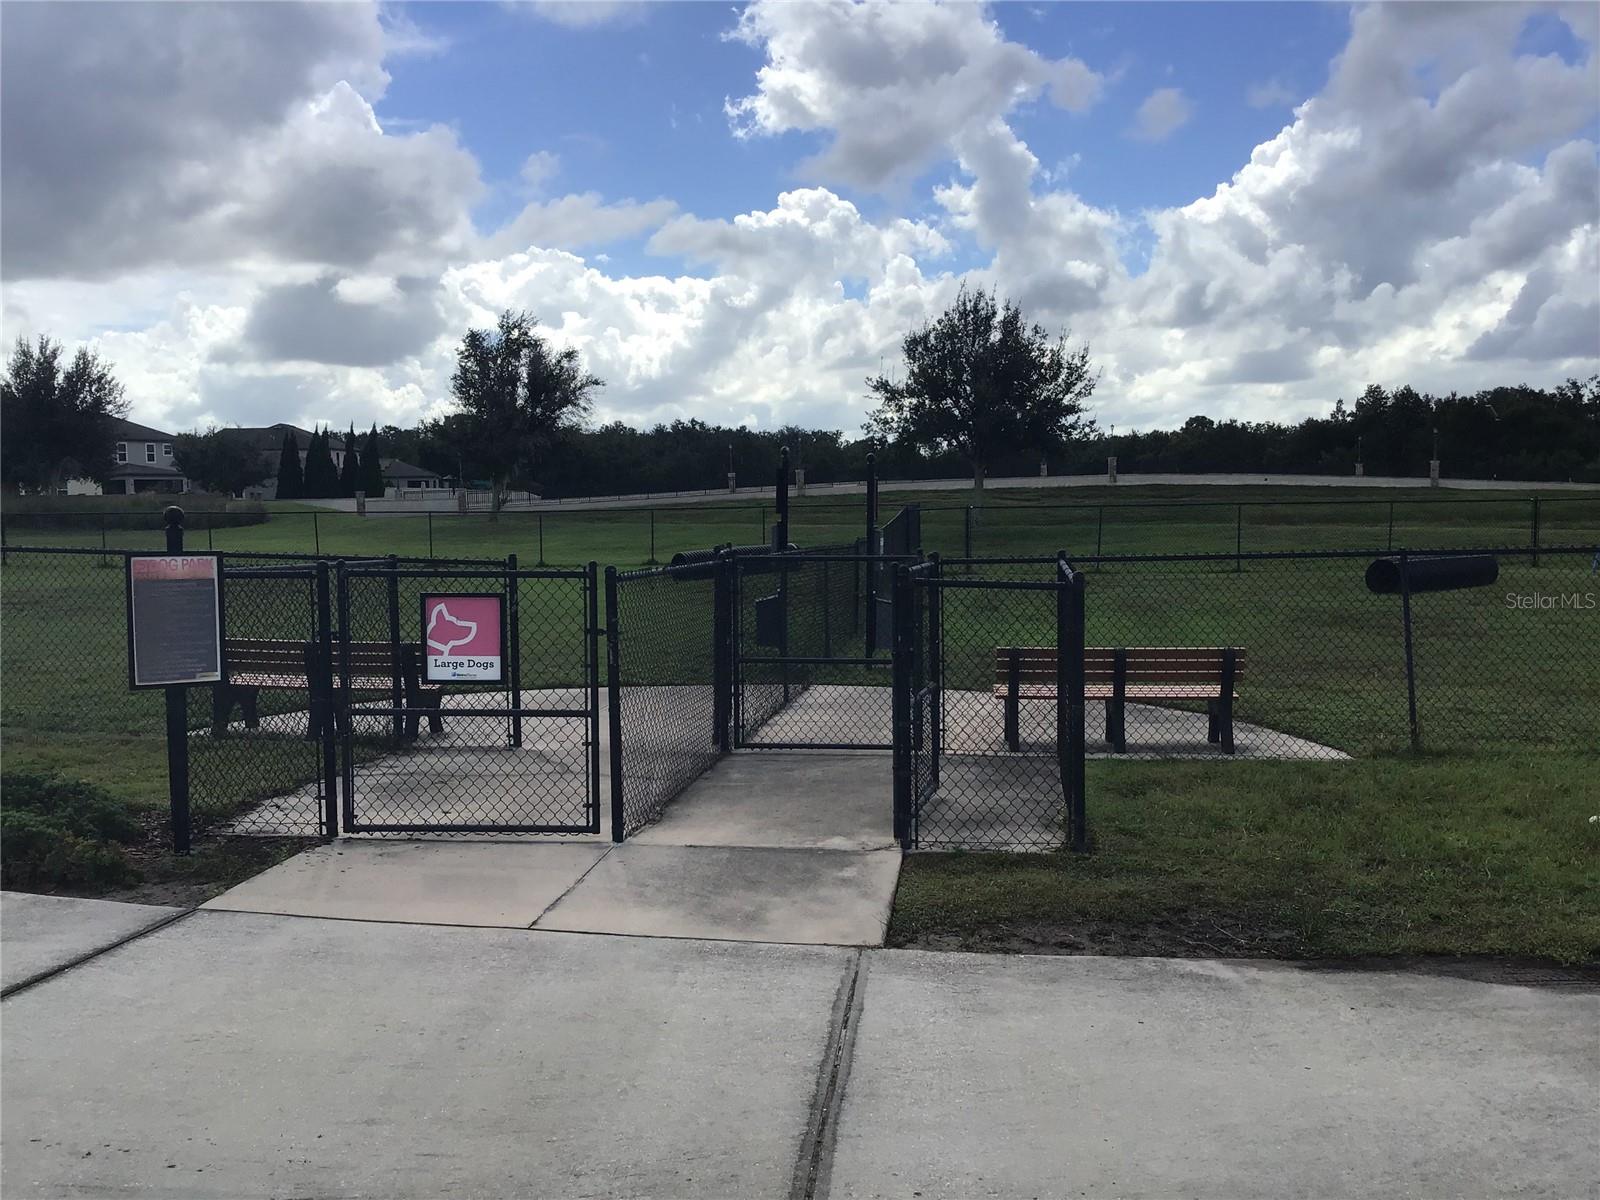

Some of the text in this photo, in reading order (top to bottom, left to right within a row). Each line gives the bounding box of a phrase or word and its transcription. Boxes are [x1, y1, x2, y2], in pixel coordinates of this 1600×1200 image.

[149, 558, 178, 571] OG
[434, 659, 495, 670] Large Dogs
